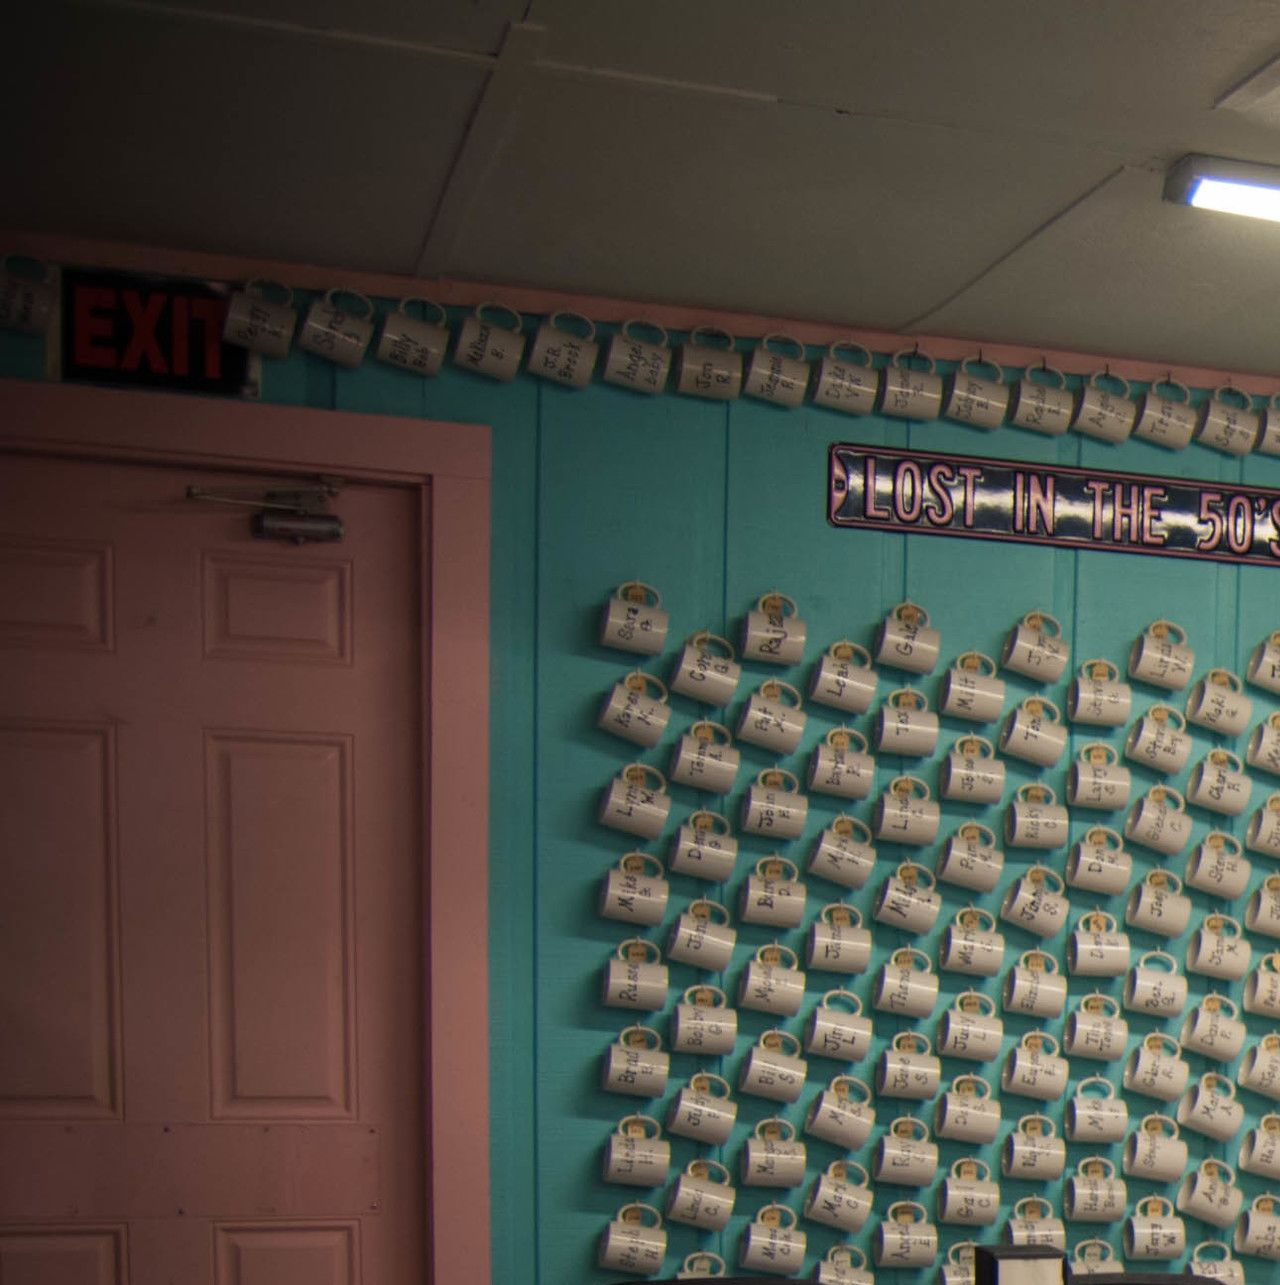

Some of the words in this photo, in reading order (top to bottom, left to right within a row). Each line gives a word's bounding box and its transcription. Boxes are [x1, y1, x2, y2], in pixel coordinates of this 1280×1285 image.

[72, 284, 227, 378] EXIT
[864, 457, 982, 529] LOST
[1013, 471, 1056, 537] IN
[1087, 480, 1169, 546] THE
